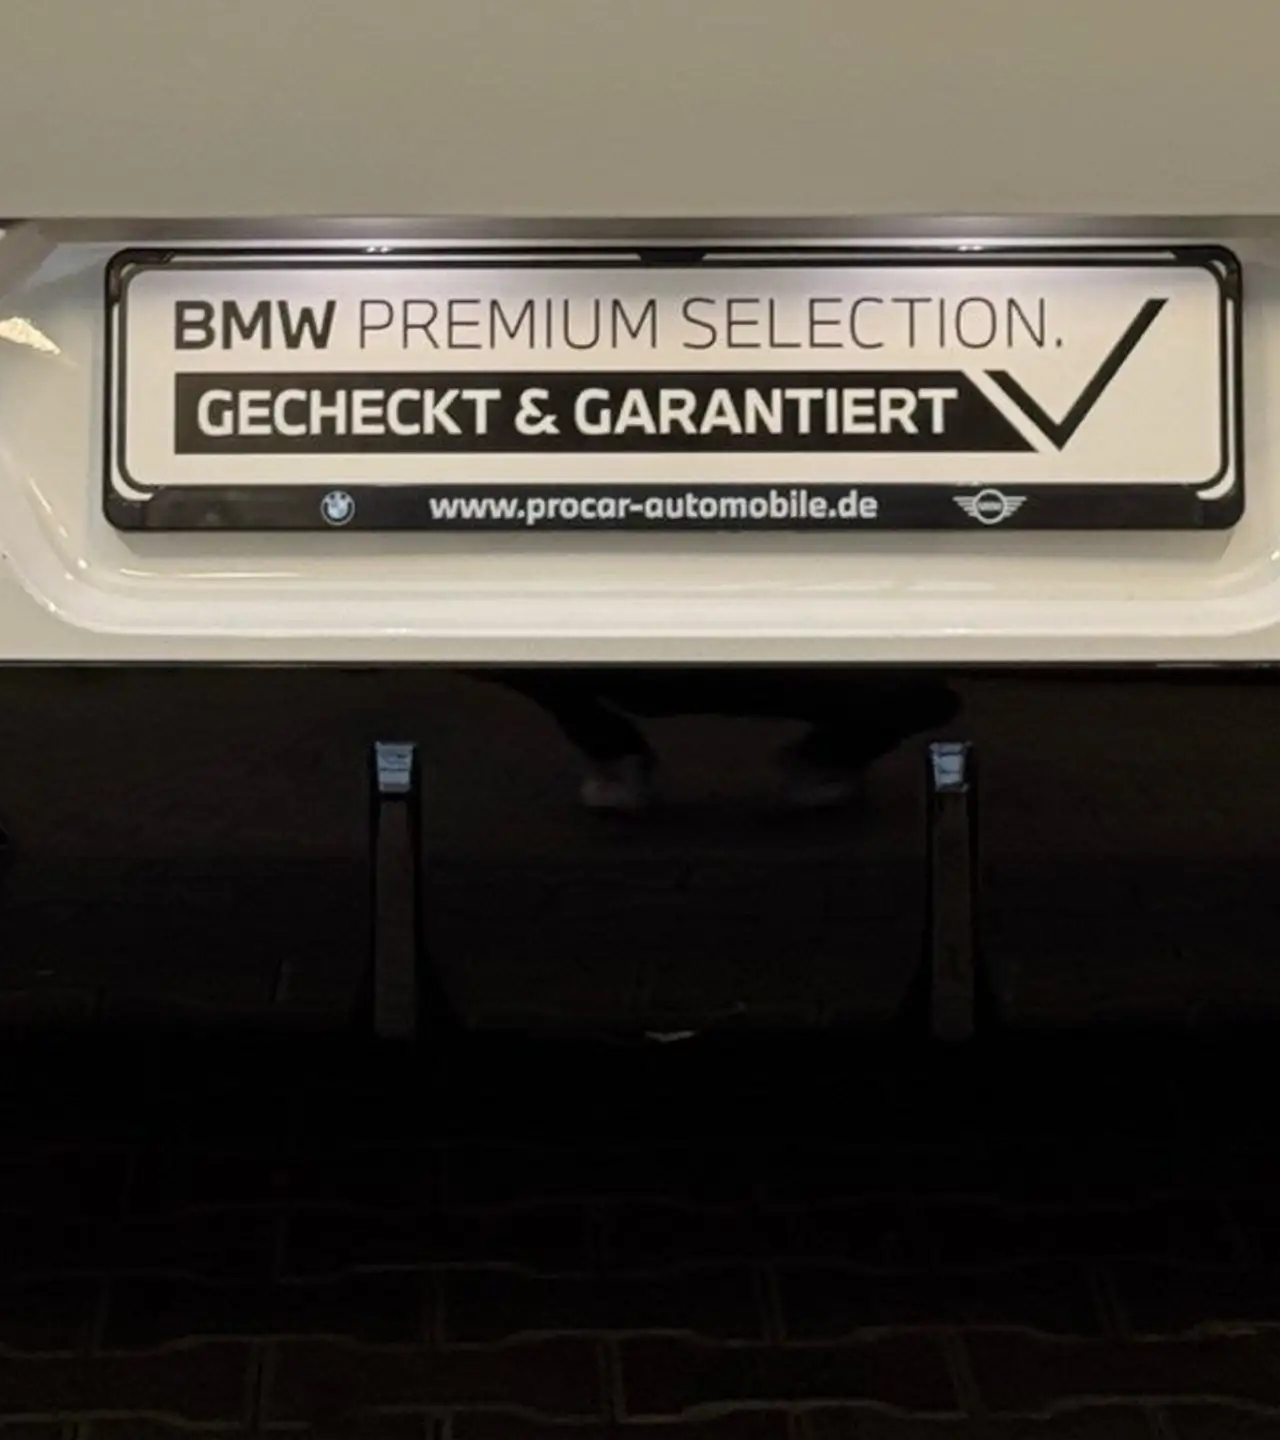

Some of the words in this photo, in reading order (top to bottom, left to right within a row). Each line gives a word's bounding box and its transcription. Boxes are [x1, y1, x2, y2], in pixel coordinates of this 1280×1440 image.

[174, 299, 337, 350] BMW
[358, 297, 659, 350] PREMIUM
[681, 296, 1064, 350] SELECTION.
[196, 387, 502, 437] GECHECKT
[513, 387, 561, 437] &
[573, 387, 959, 436] GARANTIERT
[428, 489, 879, 526] www.procar-automobile.de
